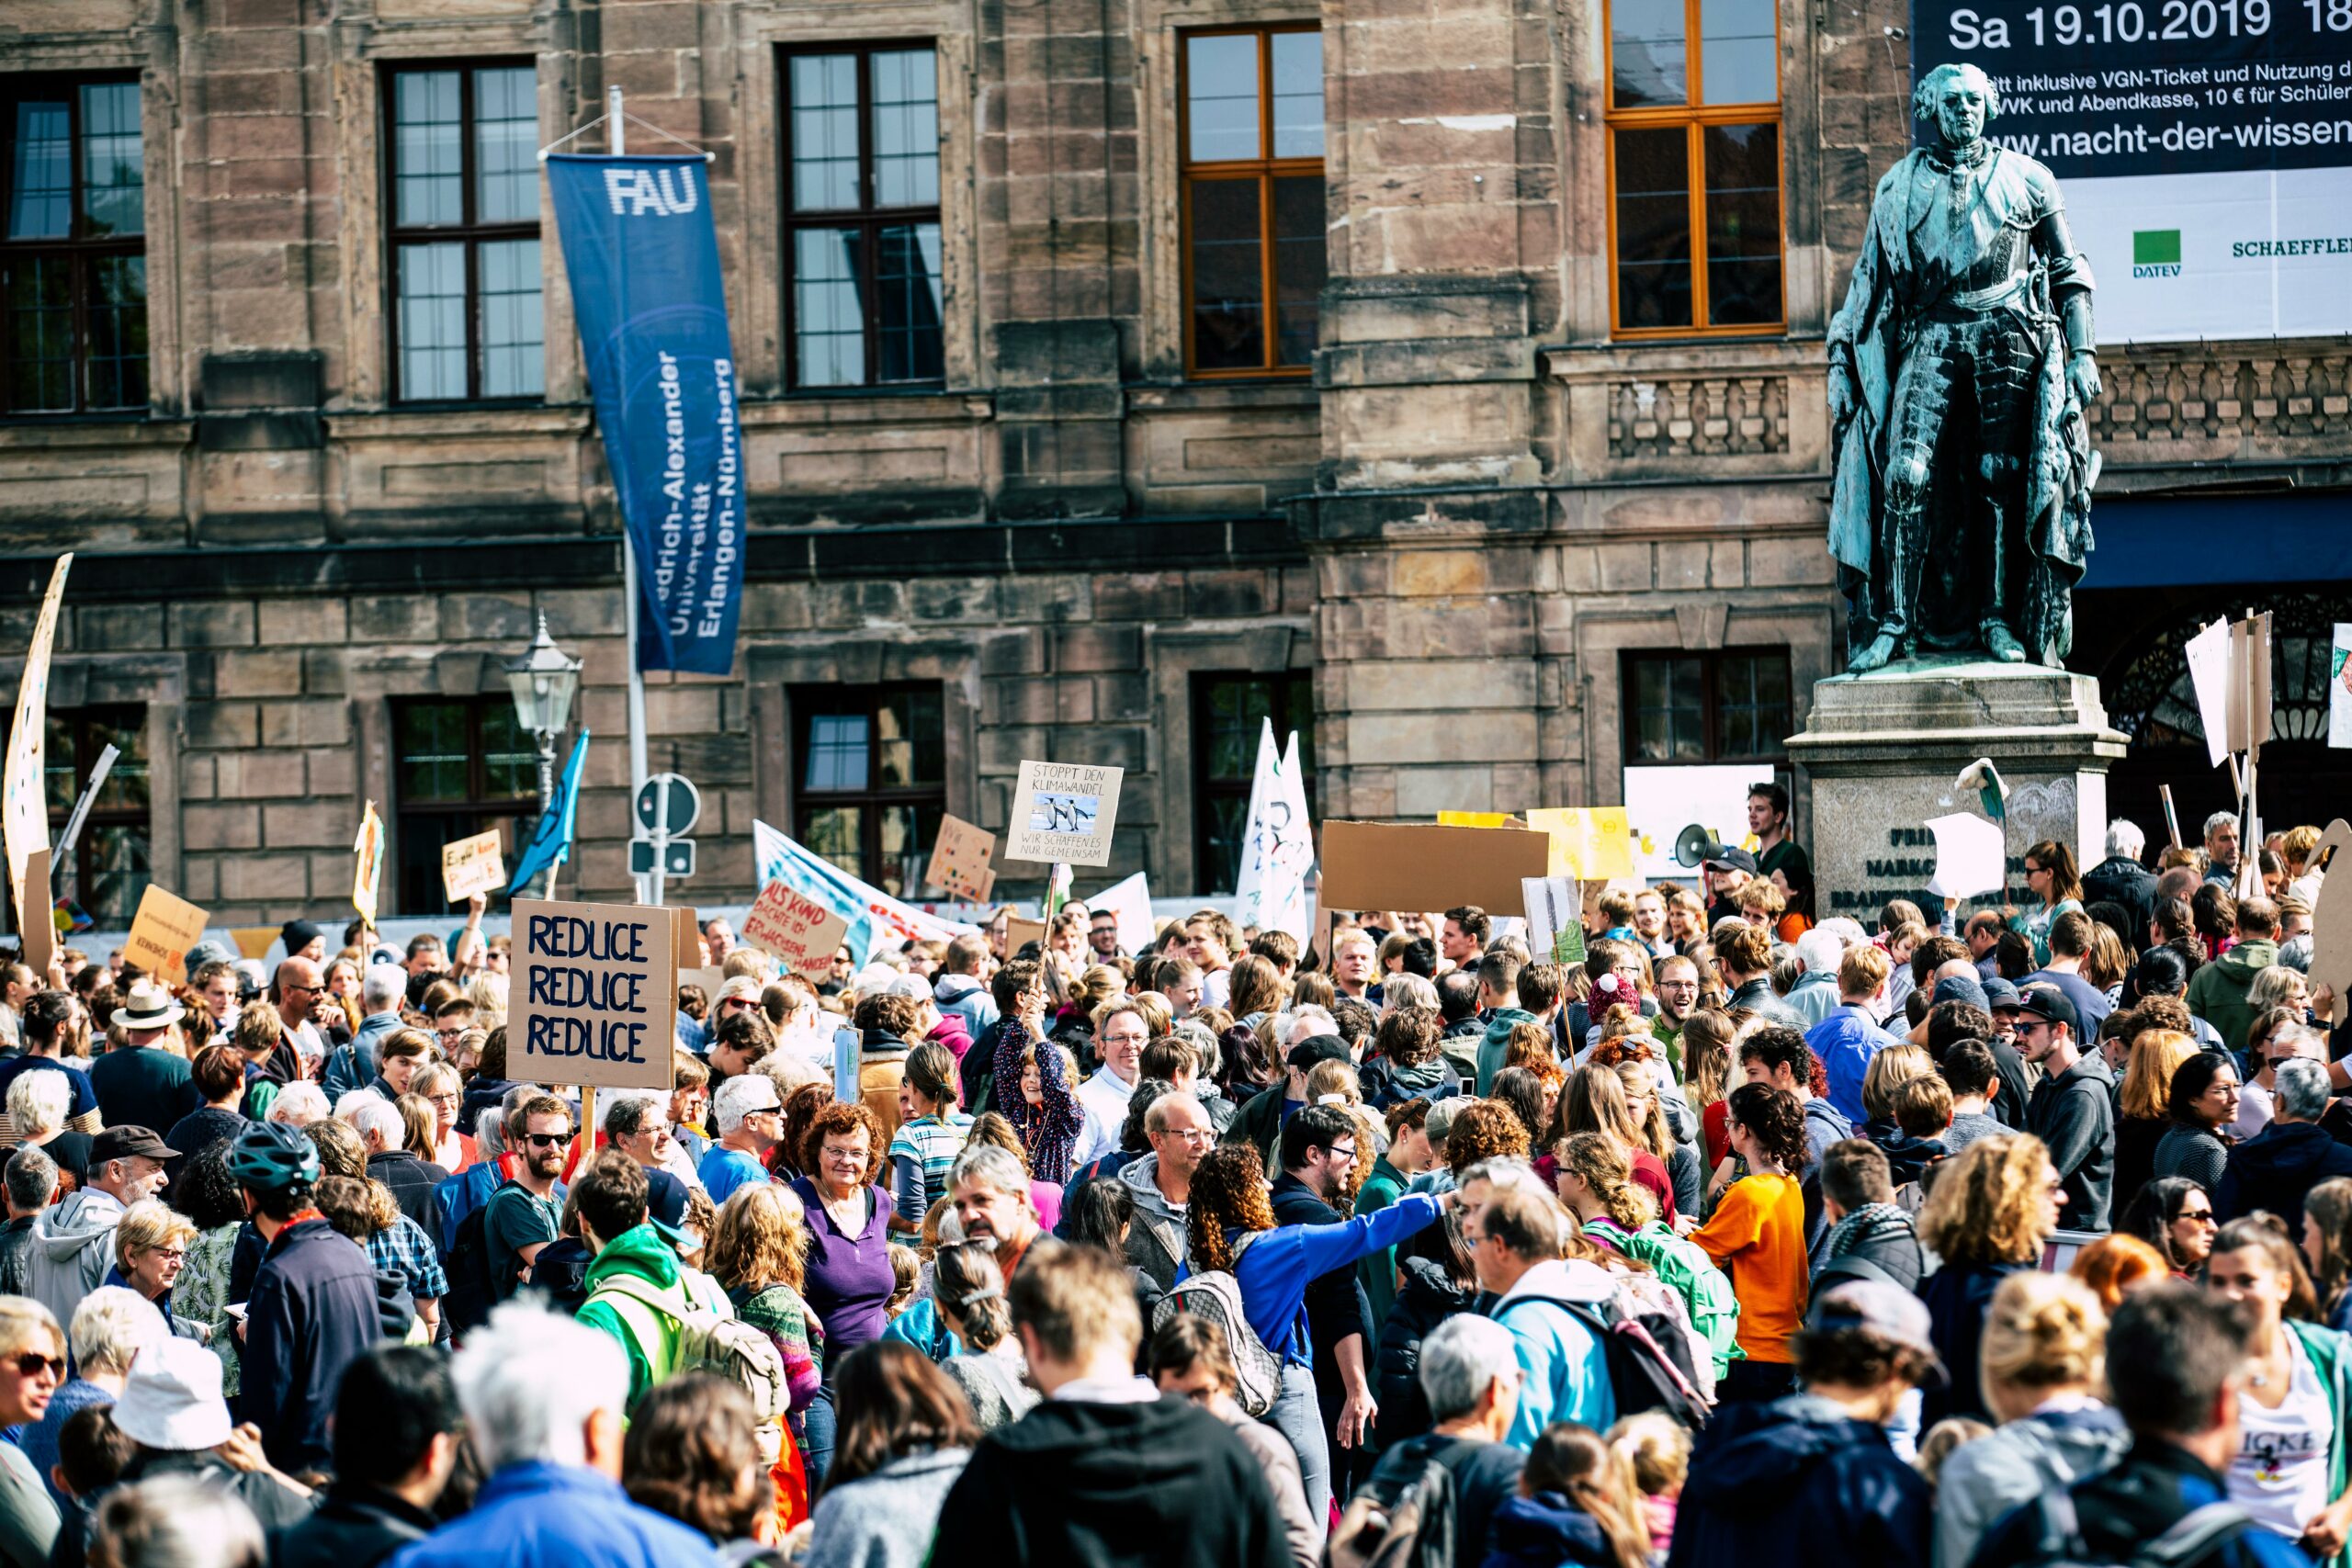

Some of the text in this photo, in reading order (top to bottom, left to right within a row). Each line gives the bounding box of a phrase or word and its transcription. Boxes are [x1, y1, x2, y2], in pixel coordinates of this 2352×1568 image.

[1949, 0, 2352, 50] Sa 19.10.2019 18
[2017, 73, 2098, 93] inklusive
[2100, 67, 2209, 90] VGN-Ticket
[2213, 65, 2249, 84] und
[2256, 62, 2334, 82] Nutzung
[2339, 60, 2351, 77] d
[2038, 96, 2074, 114] und
[2078, 91, 2199, 112] Abendkasse,
[2205, 89, 2228, 106] 10
[2233, 86, 2245, 105] €
[2250, 86, 2275, 104] für
[2280, 84, 2352, 103] Schüler
[603, 165, 698, 216] FAU
[2233, 237, 2352, 258] SCHAEFFLE
[2133, 265, 2182, 279] DATEV
[696, 358, 737, 637] Erlangen-Nürnberg
[669, 481, 712, 636] Universität
[1032, 779, 1104, 796] KLIMAWANDEL
[1033, 764, 1105, 782] STOPPT DEN
[1020, 844, 1101, 859] NUR GEMEINSAM
[1021, 832, 1102, 848] WIR SCHAFFEN ES
[762, 881, 790, 907] ALS
[753, 899, 808, 935] DACHTE ICH
[528, 915, 649, 963] REDUCE
[744, 916, 807, 957] ERWACHSENE
[528, 964, 648, 1013] REDUCE
[526, 1013, 648, 1064] REDUCE
